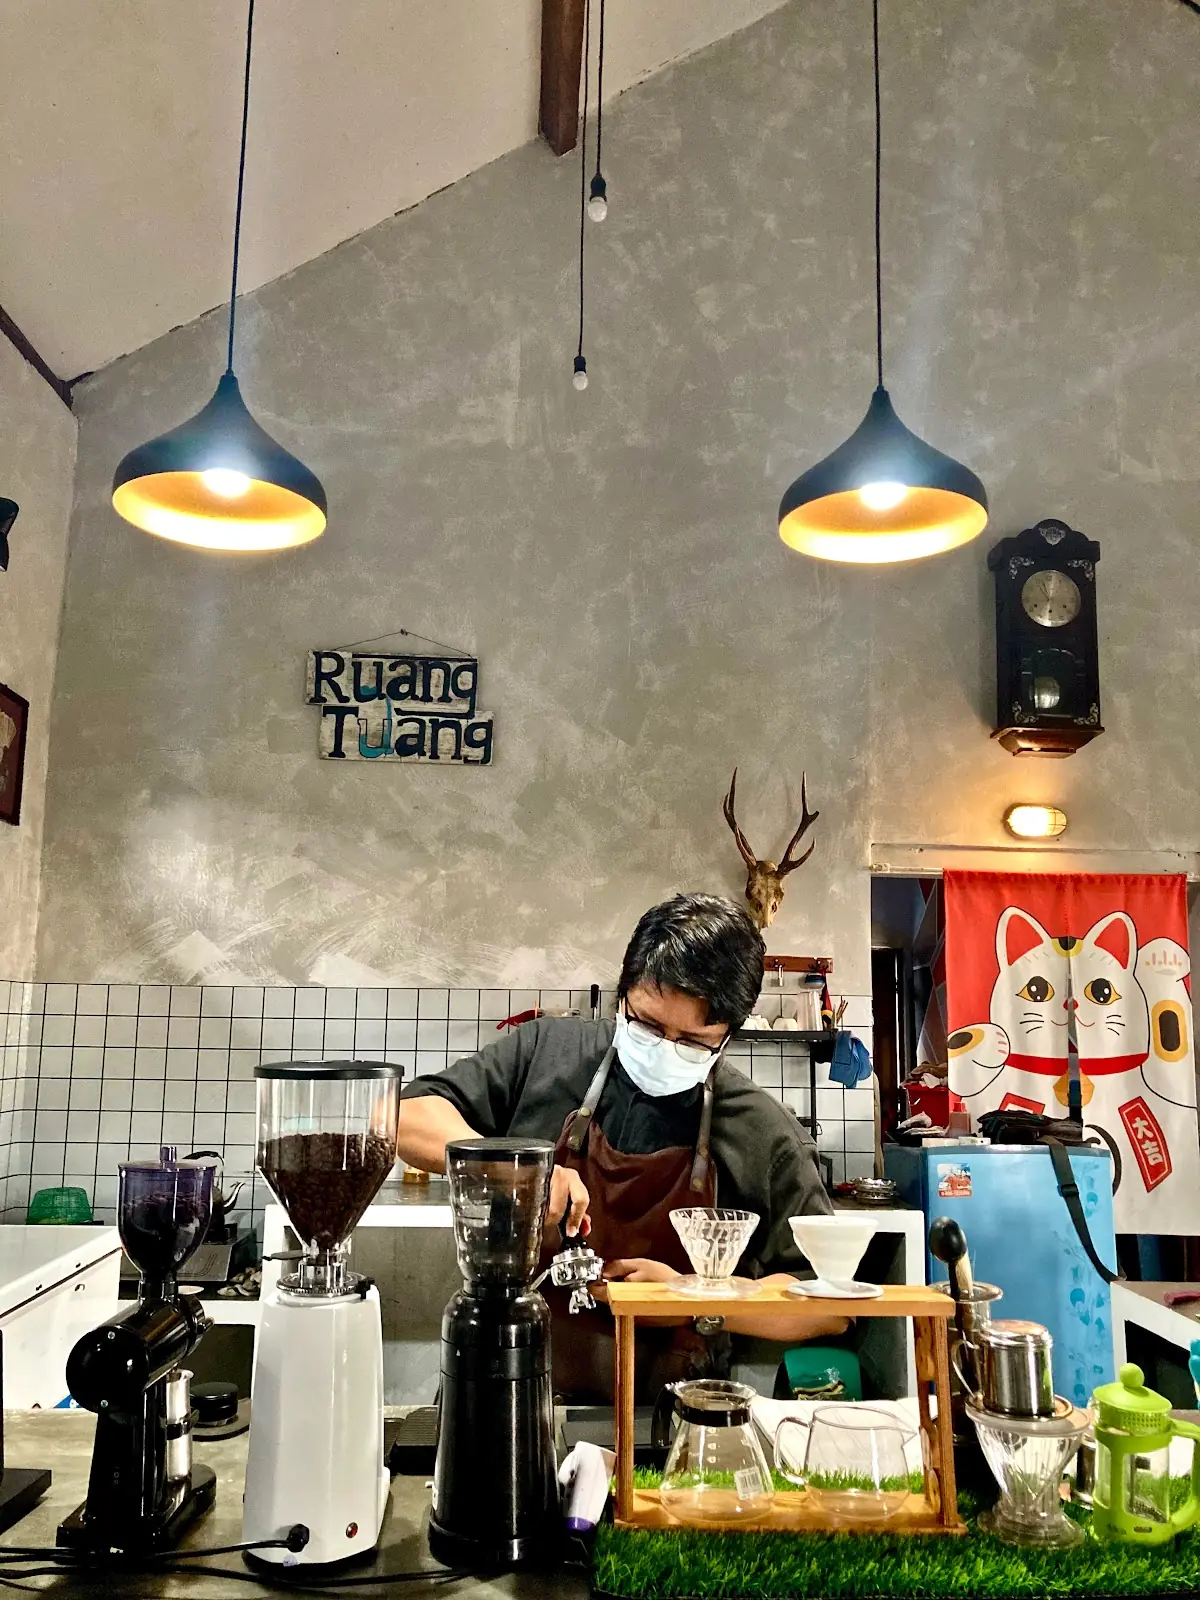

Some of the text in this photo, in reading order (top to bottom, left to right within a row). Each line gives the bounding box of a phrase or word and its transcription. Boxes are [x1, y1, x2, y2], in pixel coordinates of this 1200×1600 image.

[309, 651, 478, 719] Ruang
[322, 705, 494, 764] Tuang
[1131, 1116, 1164, 1166] 大吉
